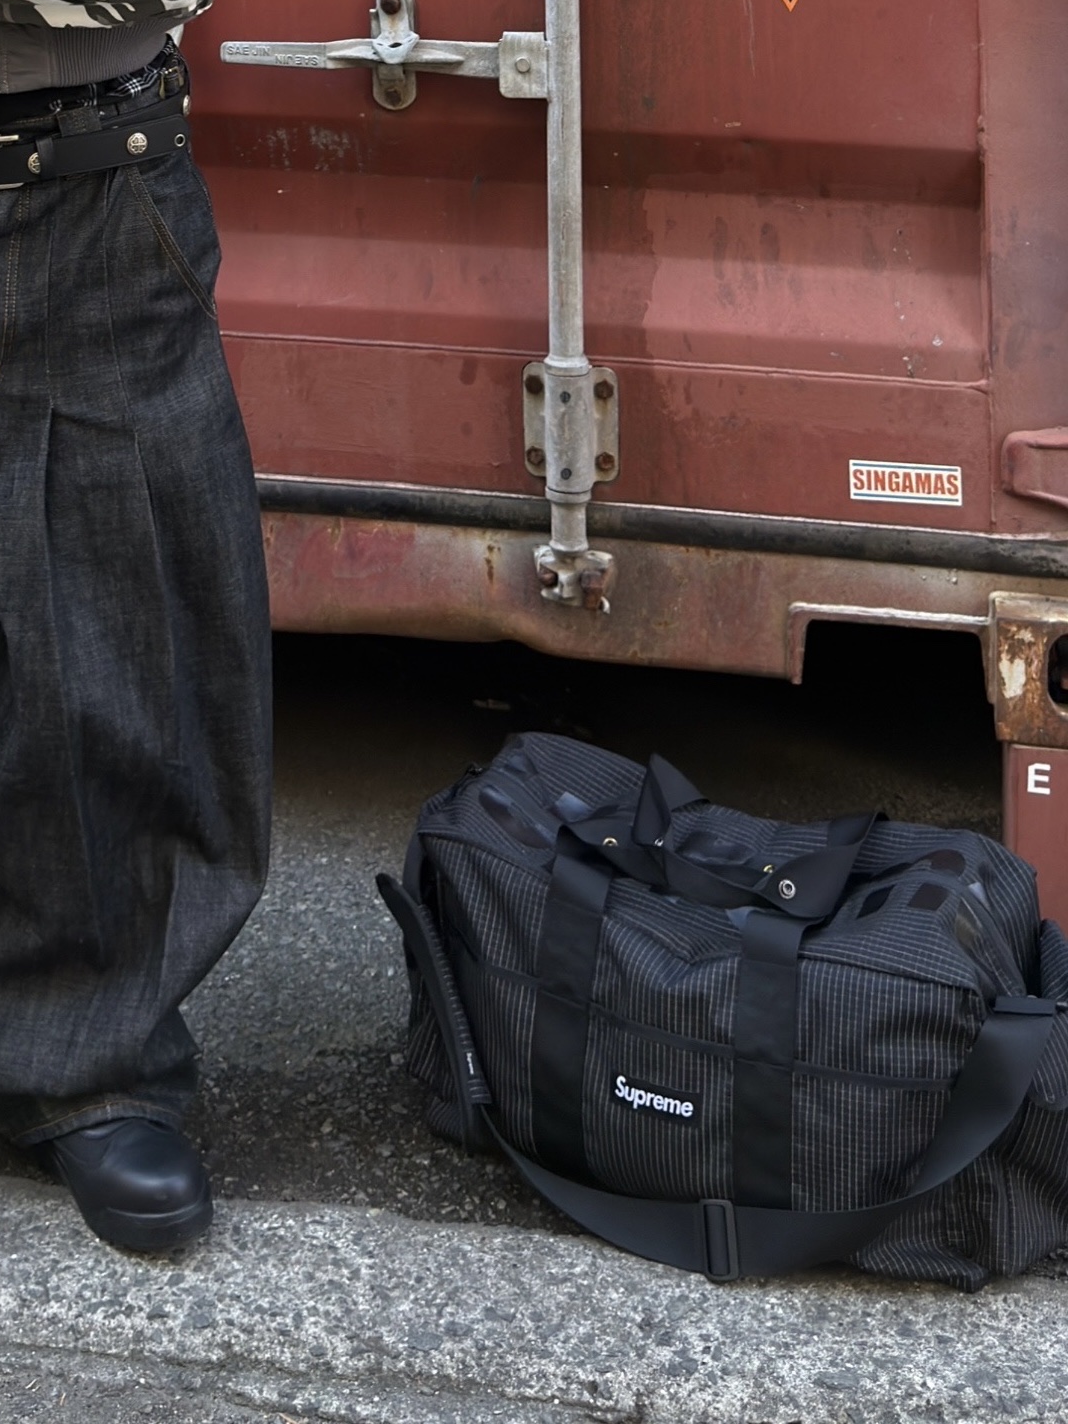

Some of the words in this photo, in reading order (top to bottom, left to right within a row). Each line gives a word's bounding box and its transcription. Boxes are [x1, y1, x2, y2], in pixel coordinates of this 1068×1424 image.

[226, 44, 250, 56] SAE
[852, 468, 959, 496] SINGAMAS
[1027, 762, 1051, 795] E
[615, 1075, 694, 1117] Supreme
